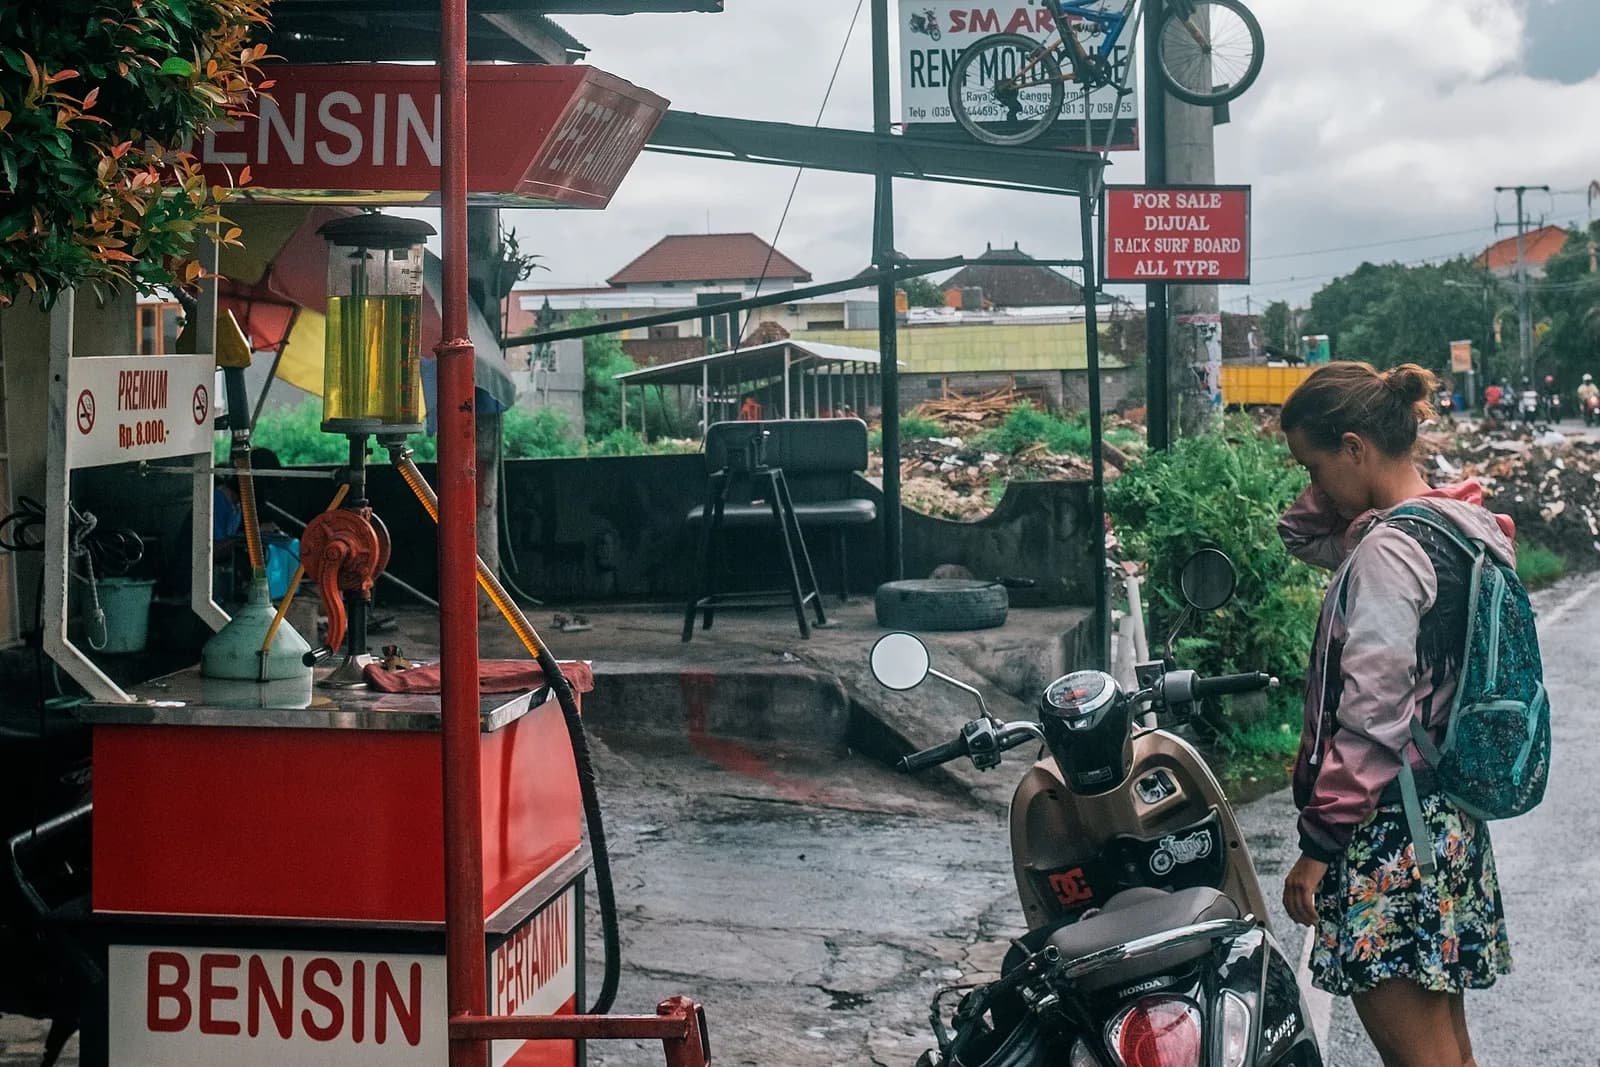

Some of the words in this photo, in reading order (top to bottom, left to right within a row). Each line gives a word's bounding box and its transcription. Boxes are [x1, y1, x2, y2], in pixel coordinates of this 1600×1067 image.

[909, 106, 926, 119] Telp
[1133, 193, 1171, 209] FOR
[1176, 193, 1222, 209] SALE
[1144, 215, 1210, 231] DIJUAL
[1114, 238, 1151, 253] RACK
[1154, 238, 1190, 253] SURF
[1193, 238, 1241, 253] BOARD
[1134, 260, 1168, 275] ALL
[1173, 260, 1220, 275] TYPE
[118, 370, 168, 411] PREMIUM
[119, 423, 135, 449] Rp.
[497, 892, 568, 1017] PERTAMINI
[1119, 979, 1162, 998] HONDA
[146, 950, 422, 1047] BENSIN
